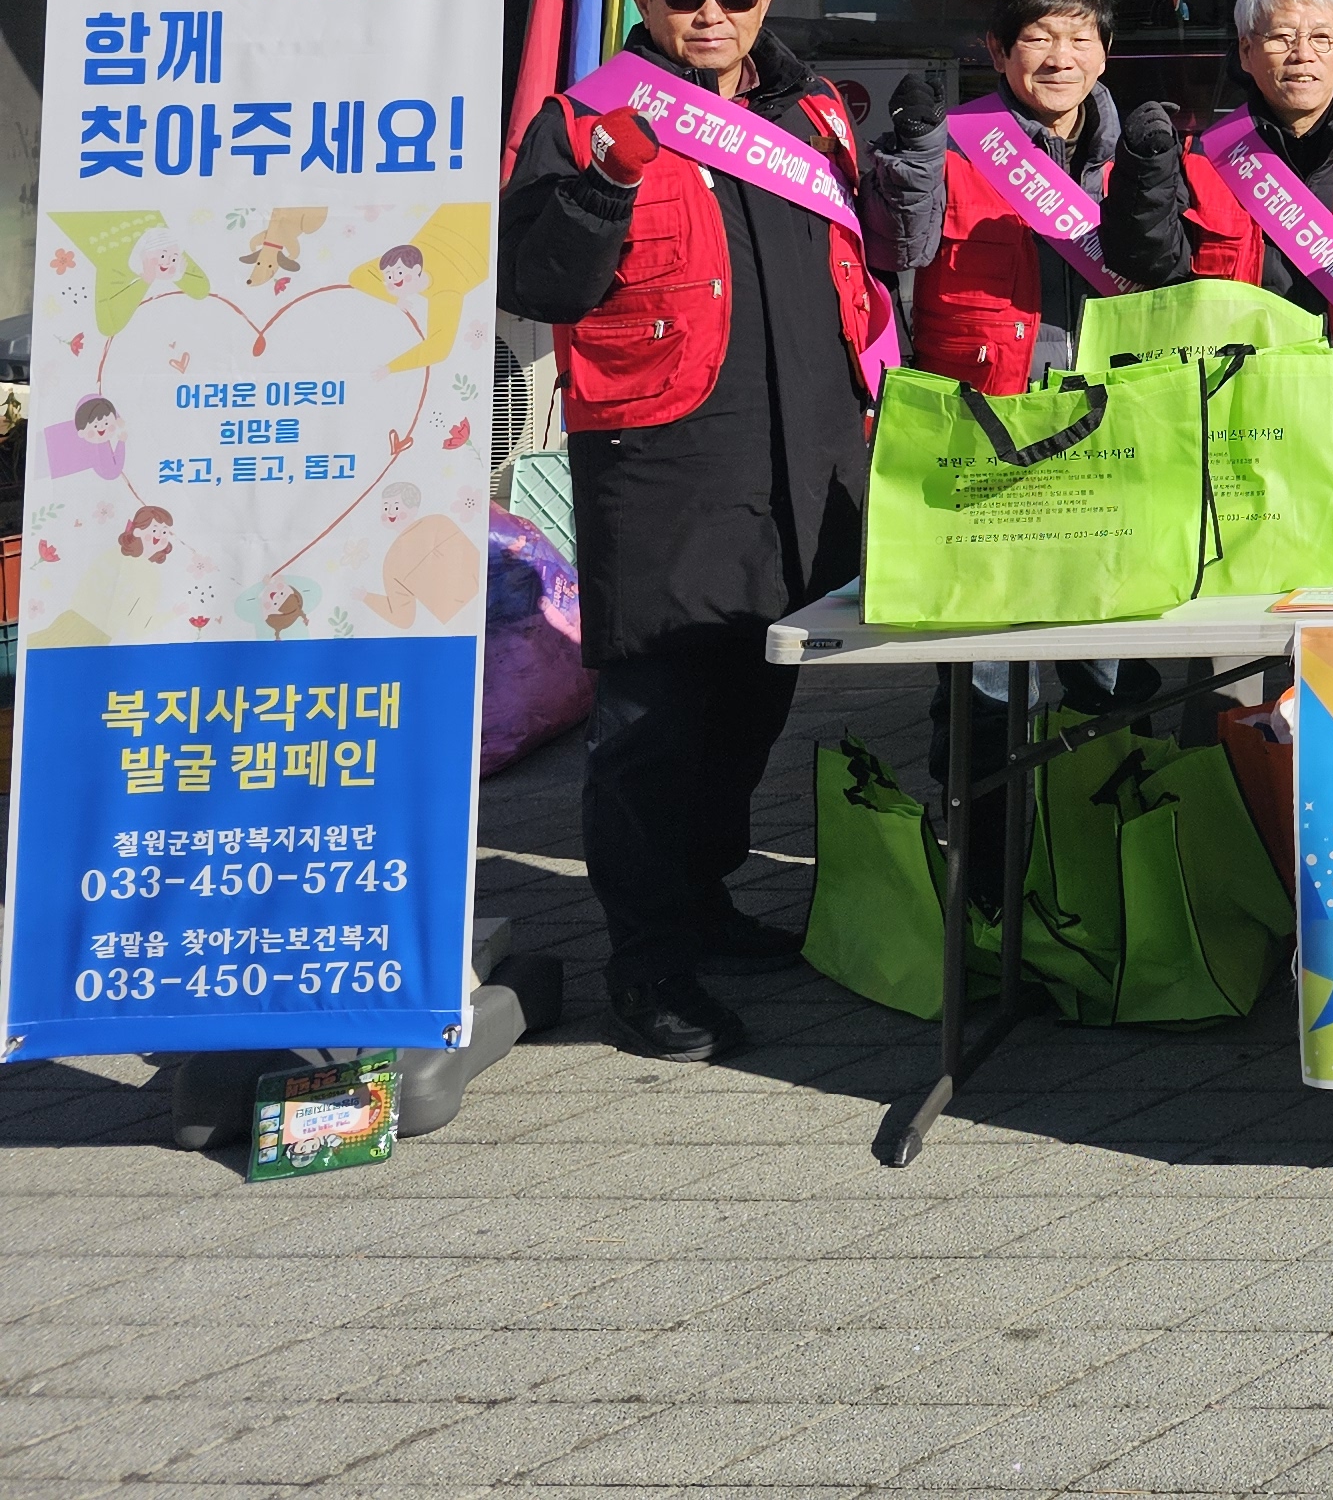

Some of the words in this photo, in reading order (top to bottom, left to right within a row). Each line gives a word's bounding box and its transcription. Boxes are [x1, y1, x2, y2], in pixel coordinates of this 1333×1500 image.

[83, 10, 223, 86] 함께
[79, 96, 465, 180] 찾아주세요!
[675, 103, 747, 154] 어려운
[746, 135, 811, 187] 이웃을
[1008, 159, 1065, 219] 어려운
[1251, 172, 1301, 229] 어려운
[175, 382, 257, 409] 어려운
[265, 380, 347, 407] 이웃의
[219, 418, 301, 446] 희망을
[158, 457, 223, 486] 찾고,
[231, 455, 294, 484] 듣고,
[303, 453, 356, 481] 돕고
[935, 456, 977, 468] 철원군
[101, 681, 402, 738] 복지사각지대
[120, 743, 217, 795] 발굴
[230, 738, 378, 791] 캠페인
[112, 824, 377, 858] 철원군희망복지지원단
[80, 859, 409, 903] 033-450-5743
[90, 928, 169, 959] 갈말읍
[180, 924, 390, 957] 찾아가는보건복지
[74, 959, 403, 1003] 033-450-5756
